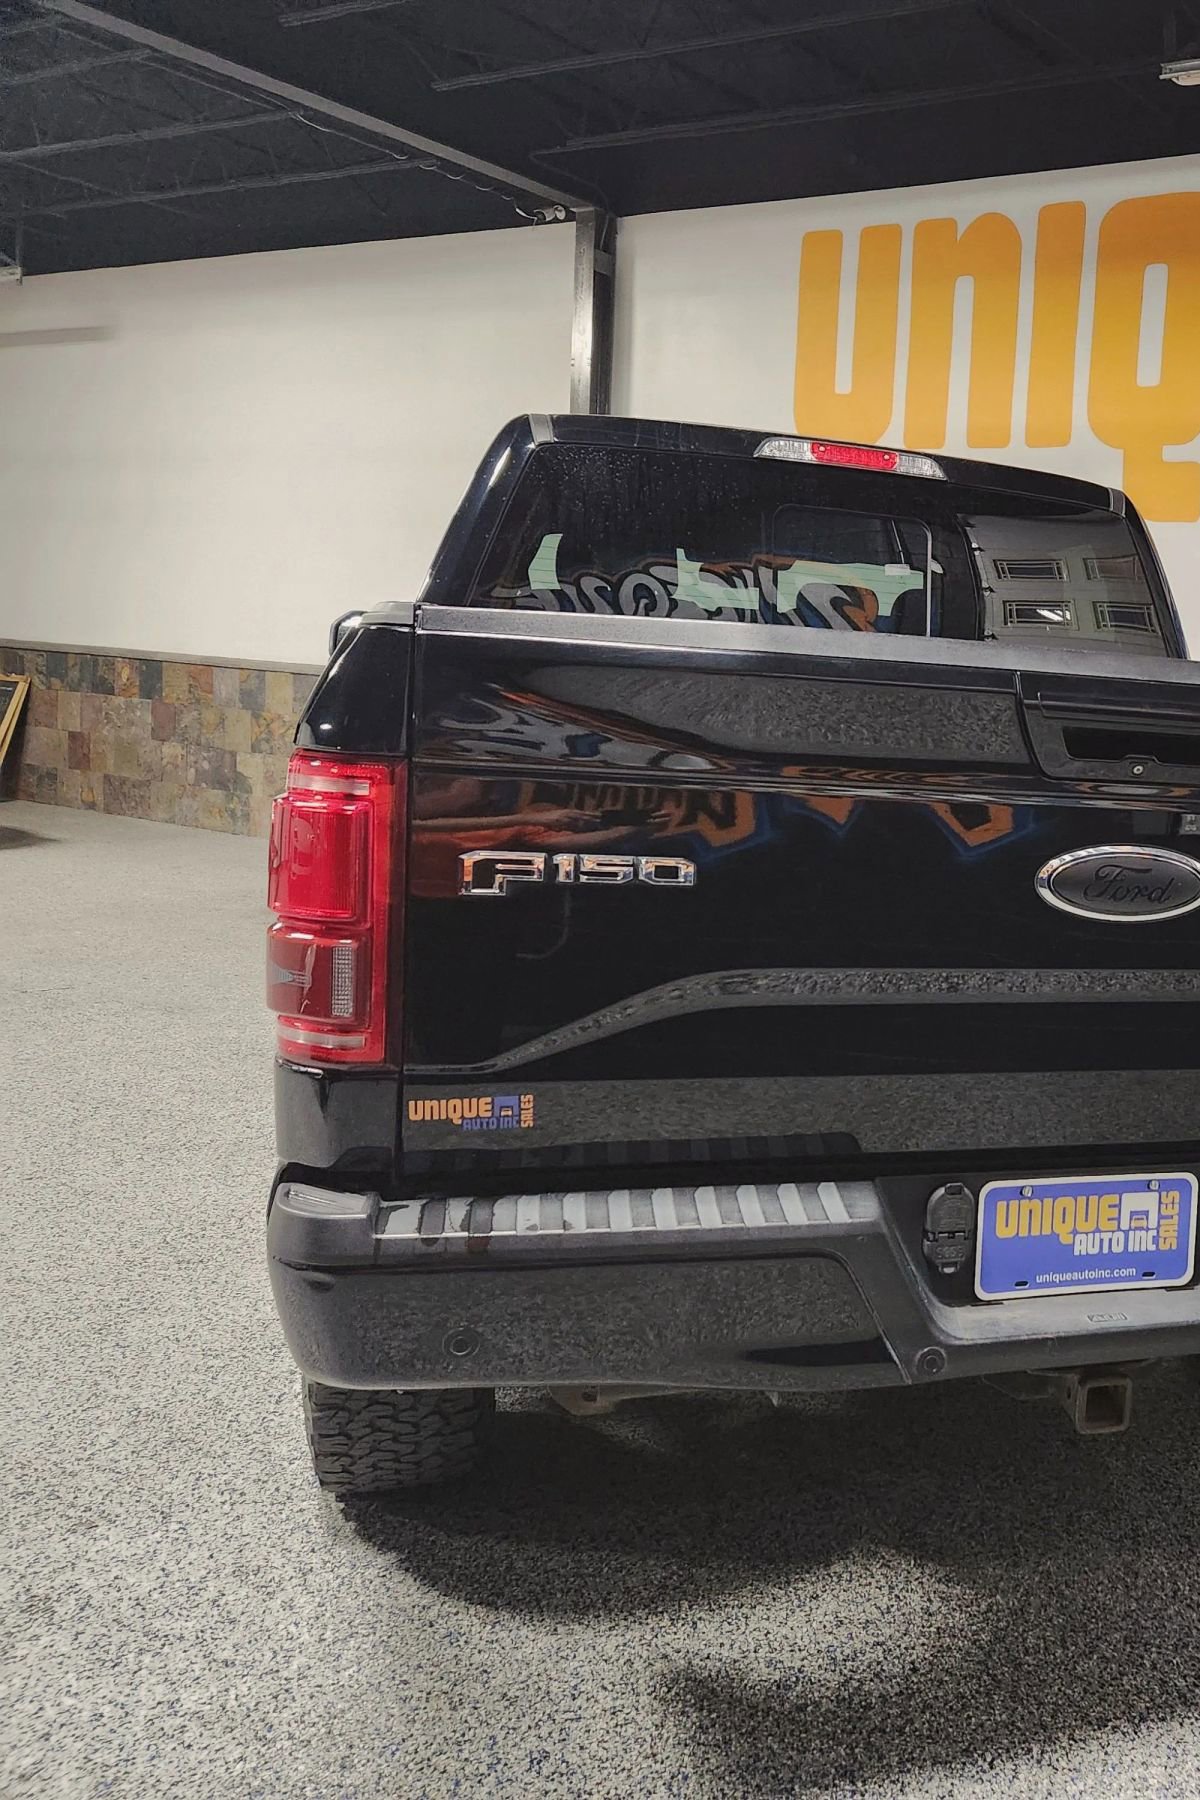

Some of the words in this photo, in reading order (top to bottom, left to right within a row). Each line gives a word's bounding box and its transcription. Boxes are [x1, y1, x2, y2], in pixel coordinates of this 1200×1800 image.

[1083, 864, 1175, 904] Ford
[408, 1096, 493, 1125] UNIQUE
[462, 1117, 497, 1131] AUTO
[500, 1116, 520, 1129] INC
[520, 1094, 534, 1128] SALES
[995, 1194, 1120, 1245] UNIQUE
[1158, 1190, 1180, 1251] SALES
[1073, 1231, 1125, 1256] AUTO
[1127, 1229, 1158, 1253] INC
[1036, 1267, 1137, 1284] uniqueautoinc.com
